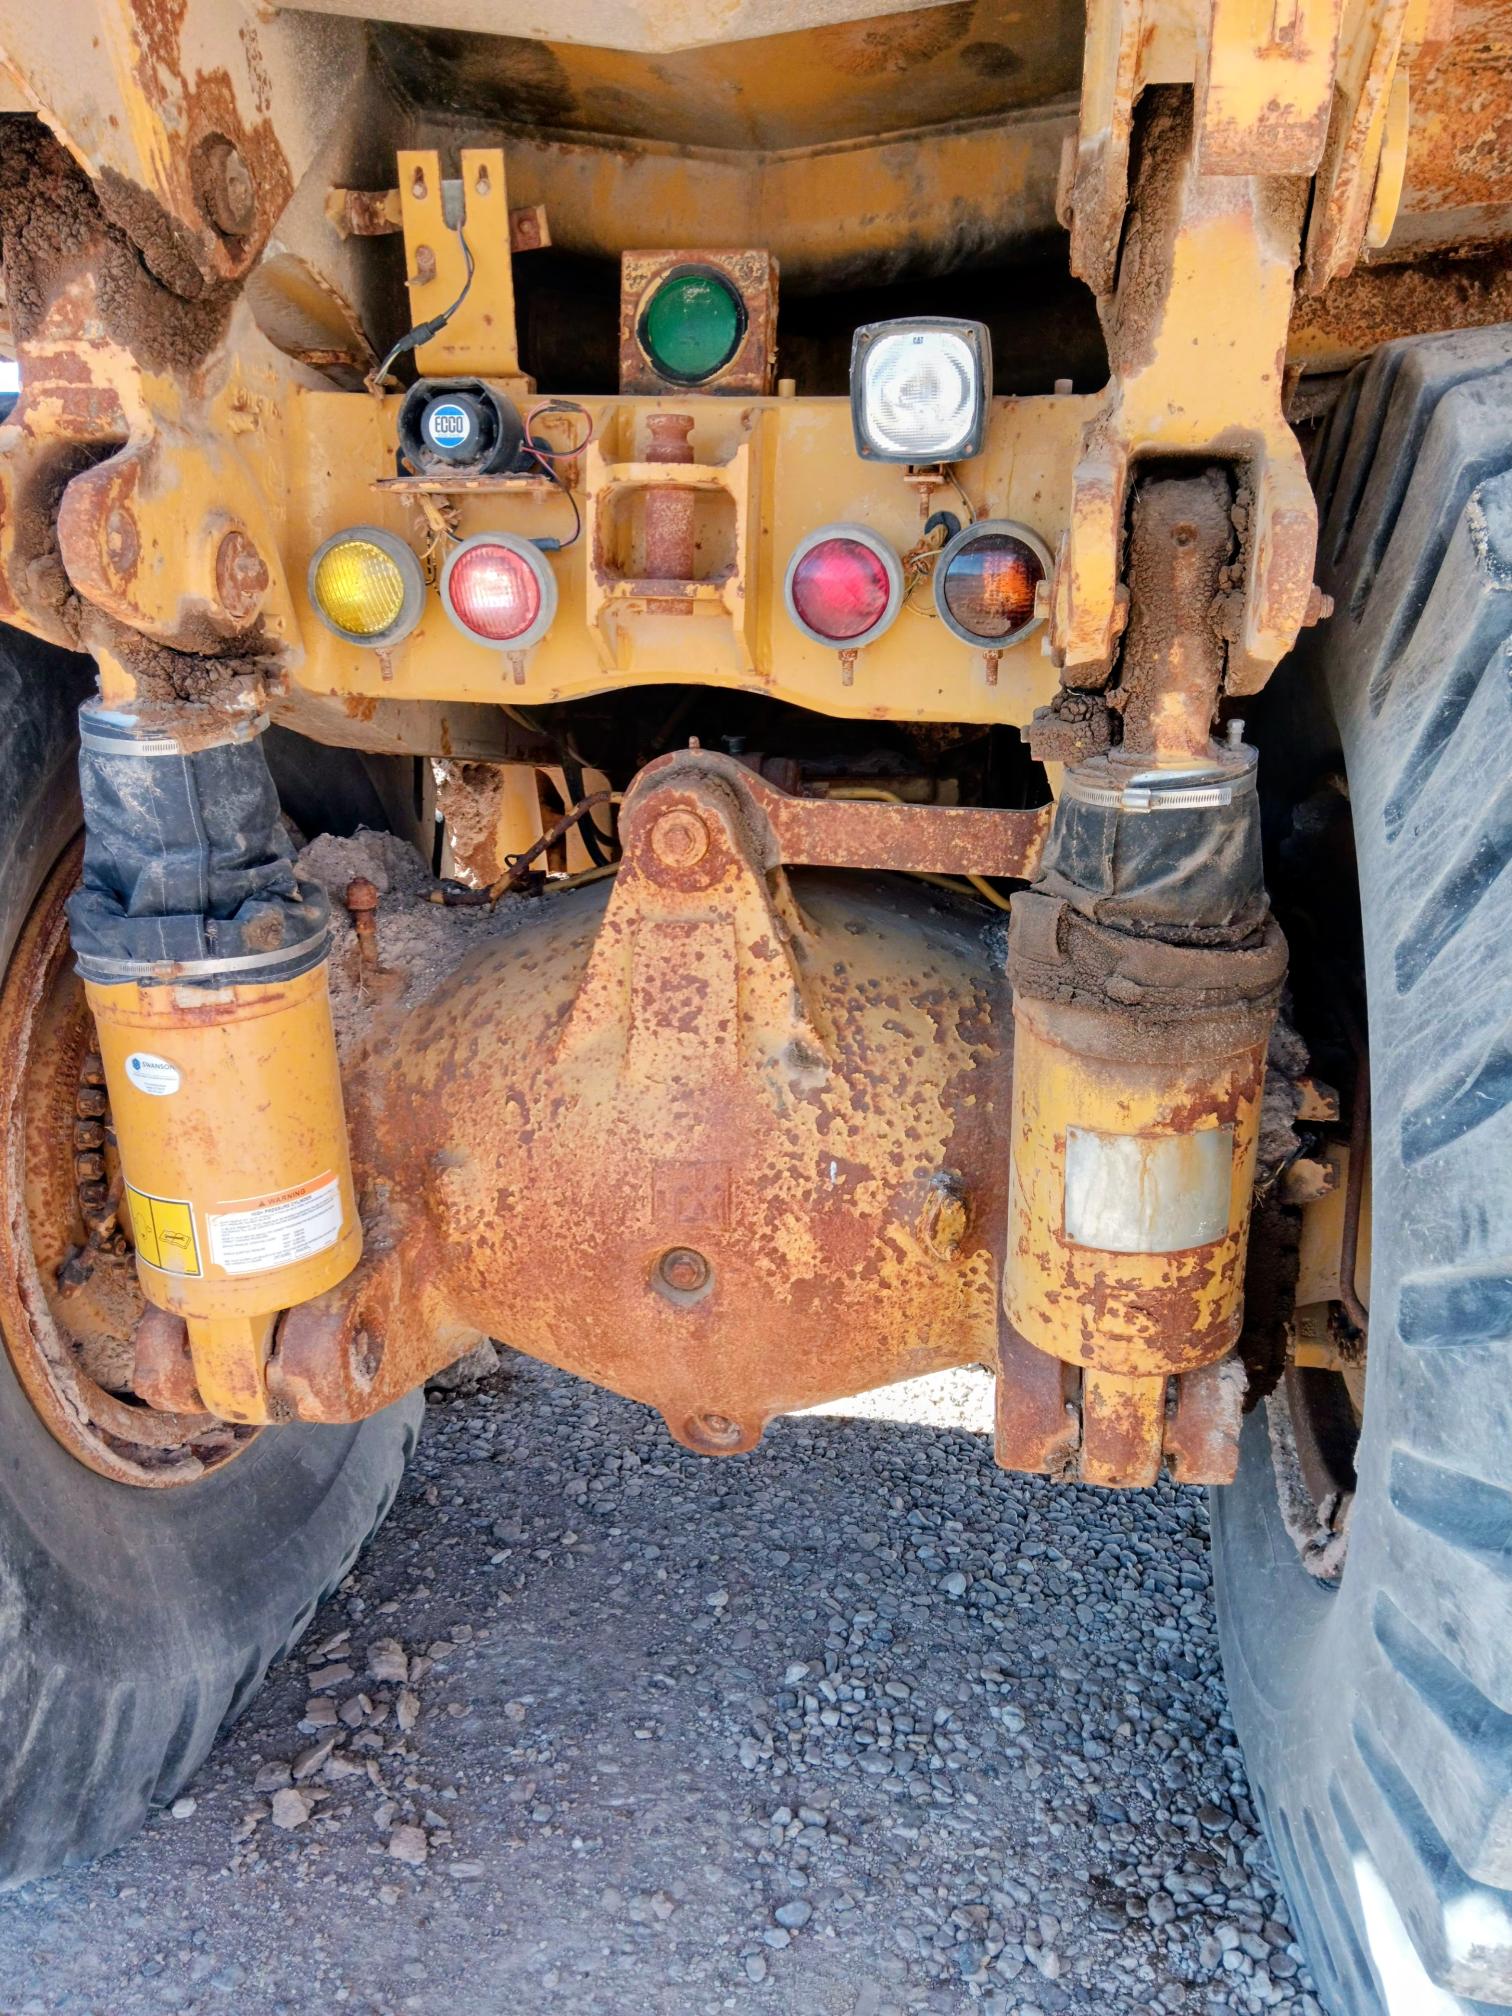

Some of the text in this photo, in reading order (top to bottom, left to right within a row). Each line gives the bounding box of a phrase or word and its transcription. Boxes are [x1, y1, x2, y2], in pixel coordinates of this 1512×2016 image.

[913, 336, 924, 344] CAT
[435, 416, 463, 433] ECCO
[142, 1061, 176, 1071] SWANSON
[268, 1189, 306, 1205] WARNING
